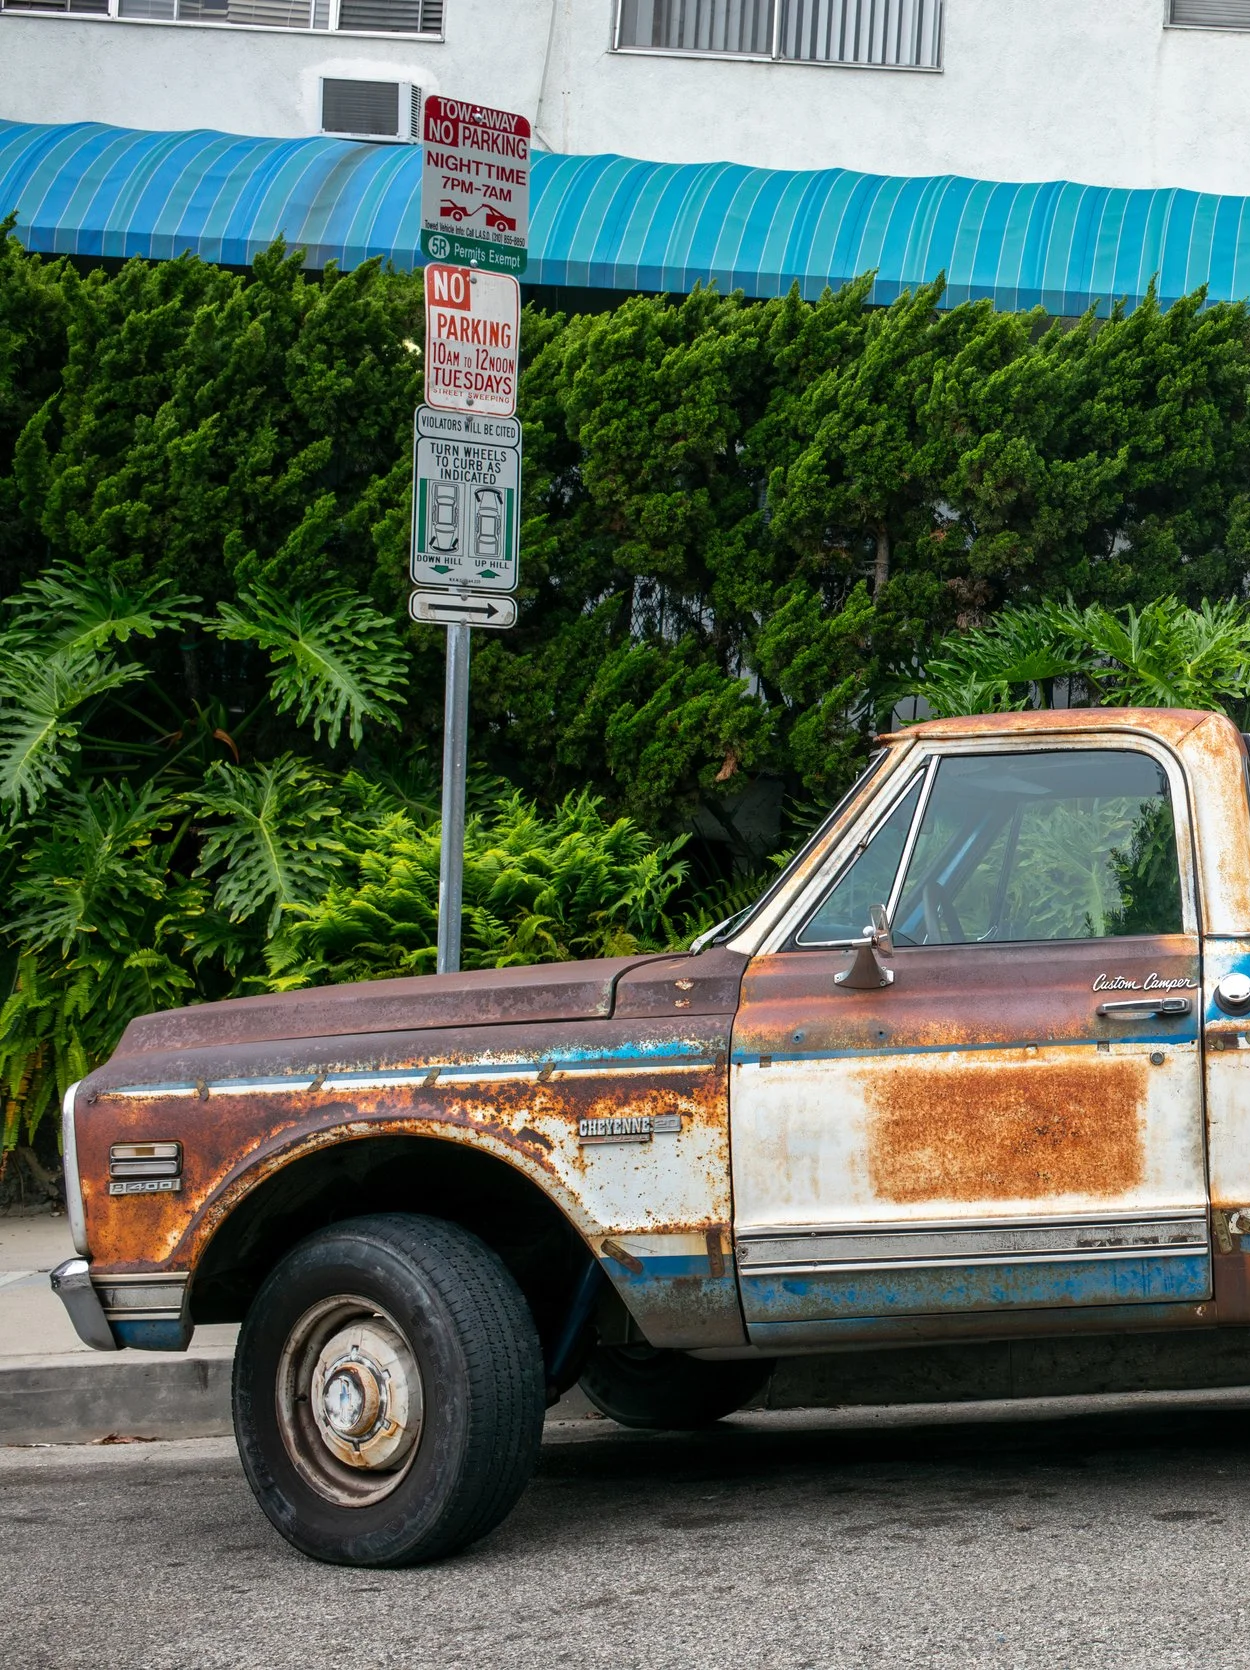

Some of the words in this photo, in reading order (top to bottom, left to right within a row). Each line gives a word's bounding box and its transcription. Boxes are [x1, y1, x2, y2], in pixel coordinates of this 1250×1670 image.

[429, 118, 453, 143] NO
[463, 125, 527, 160] PARKING
[427, 150, 526, 186] NIGHTTIME
[442, 176, 512, 202] 7PM-7AM
[425, 219, 438, 231] Towed
[440, 223, 454, 234] Vehicle
[466, 228, 474, 237] Call
[432, 238, 447, 257] 5R
[454, 243, 486, 262] Permits
[489, 250, 520, 269] Exempt
[434, 270, 464, 303] NO
[437, 313, 511, 349] PARKING
[432, 342, 460, 367] 10AM
[464, 356, 472, 368] TO
[476, 349, 514, 374] 12NOON
[433, 367, 512, 395] TUESDAYS
[433, 388, 463, 397] STREET
[468, 392, 510, 404] SWEEPING
[422, 416, 462, 432] VIOLATORS
[464, 420, 481, 434] WILL
[484, 424, 493, 436] BE
[496, 426, 516, 438] CITED
[430, 442, 459, 456] TURN
[464, 446, 506, 462] WHEELS
[436, 455, 448, 468] TO
[453, 458, 482, 472] CURB
[487, 462, 501, 474] AS
[440, 468, 496, 484] INDICATED
[417, 554, 440, 564] DOWN
[444, 557, 462, 566] HILL
[475, 560, 486, 568] UP
[490, 562, 510, 570] HILL
[1092, 974, 1141, 992] Custom
[1144, 972, 1198, 992] Camper
[580, 1117, 650, 1136] CHEYENNE
[128, 1181, 172, 1191] 400
